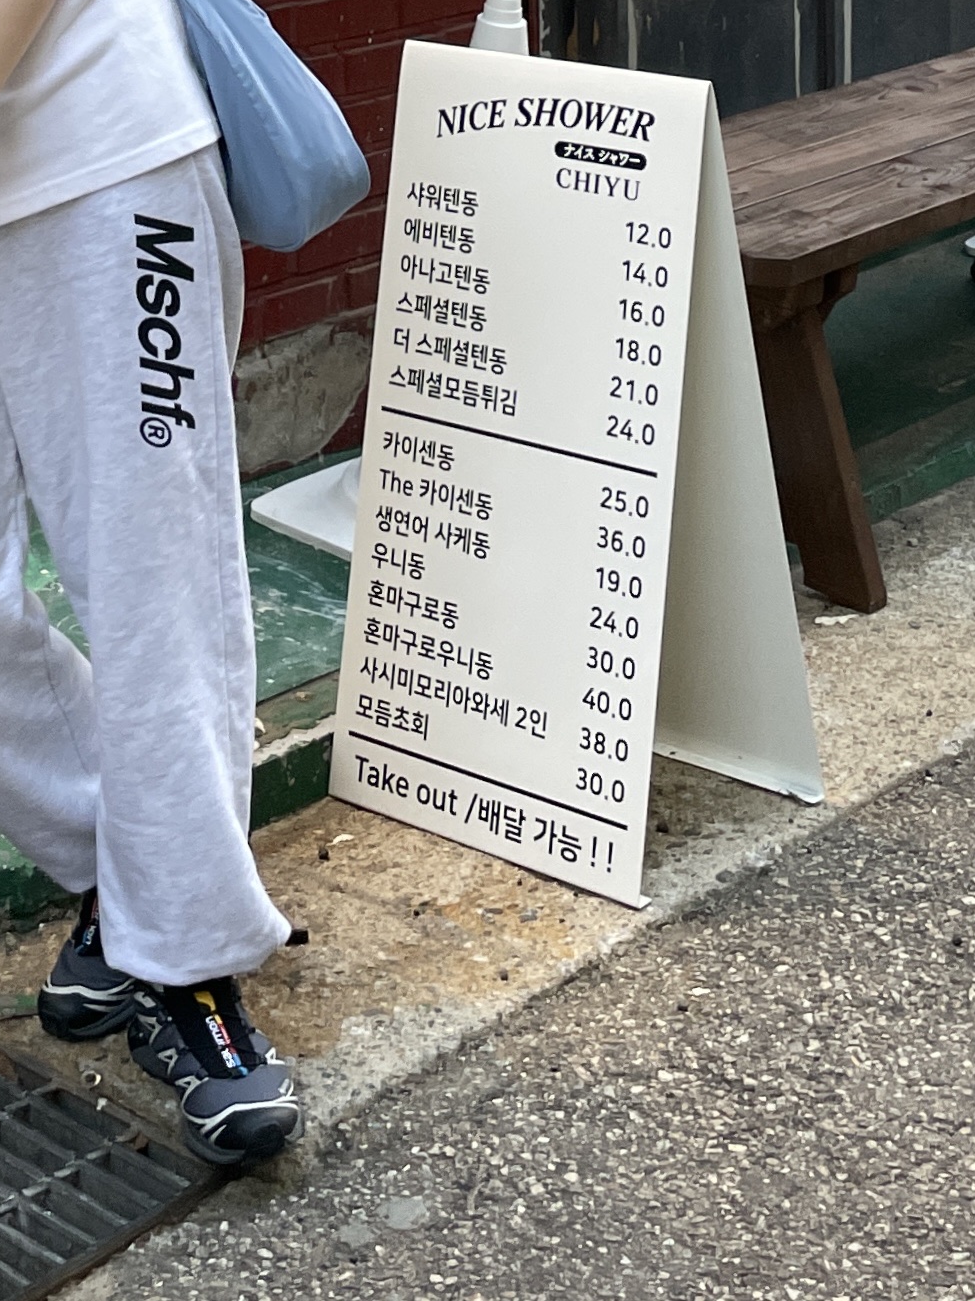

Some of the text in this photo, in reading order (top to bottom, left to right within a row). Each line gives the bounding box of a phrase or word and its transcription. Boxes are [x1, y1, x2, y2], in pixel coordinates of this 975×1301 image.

[437, 97, 655, 142] NICE SHOWER
[407, 182, 671, 249] 샤워텐동 12.0
[556, 168, 640, 201] CHIYU
[401, 254, 665, 327] 아나고텐동 16.0
[404, 218, 668, 288] 에비텐동 14.0
[393, 328, 658, 406] 더 스페셜텐동 21.0
[396, 292, 661, 366] 스페셜텐동 18.0
[388, 365, 655, 446] 스페셜모듬튀김 24.0
[379, 468, 645, 559] The 카이센동 36.0
[383, 431, 649, 518] 카이센동 25.0
[371, 543, 639, 639] 우니동 24.0
[375, 505, 642, 599] 생연어 사케동 19.0
[363, 617, 632, 721] 혼마구로우니동 40.0
[367, 579, 635, 680] 혼마구로동 30.0
[355, 694, 625, 803] 모듬초회 30.0
[360, 656, 628, 762] 사시미모리아와세 2인 38.0
[355, 754, 409, 798] Take
[416, 783, 458, 816] out
